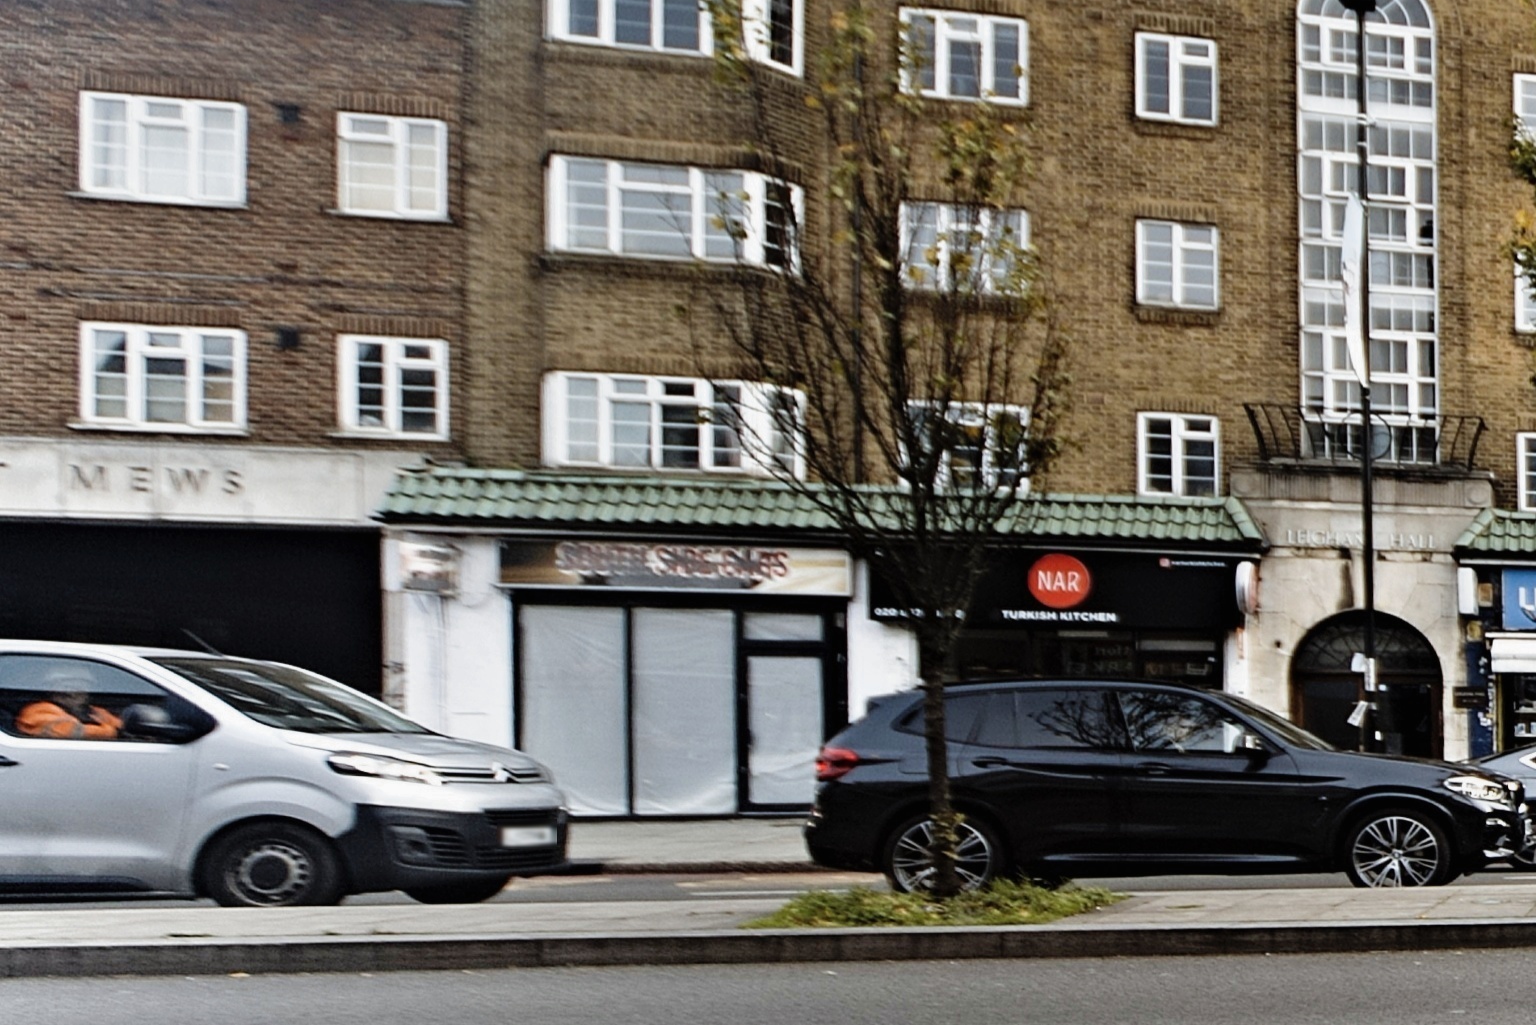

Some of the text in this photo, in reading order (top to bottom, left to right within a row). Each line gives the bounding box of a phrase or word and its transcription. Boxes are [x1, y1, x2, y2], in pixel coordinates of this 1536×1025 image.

[68, 463, 246, 495] MEWS
[1390, 533, 1436, 549] HALL
[1037, 569, 1081, 593] NAR
[1001, 609, 1117, 623] TURKISH KITCHEN
